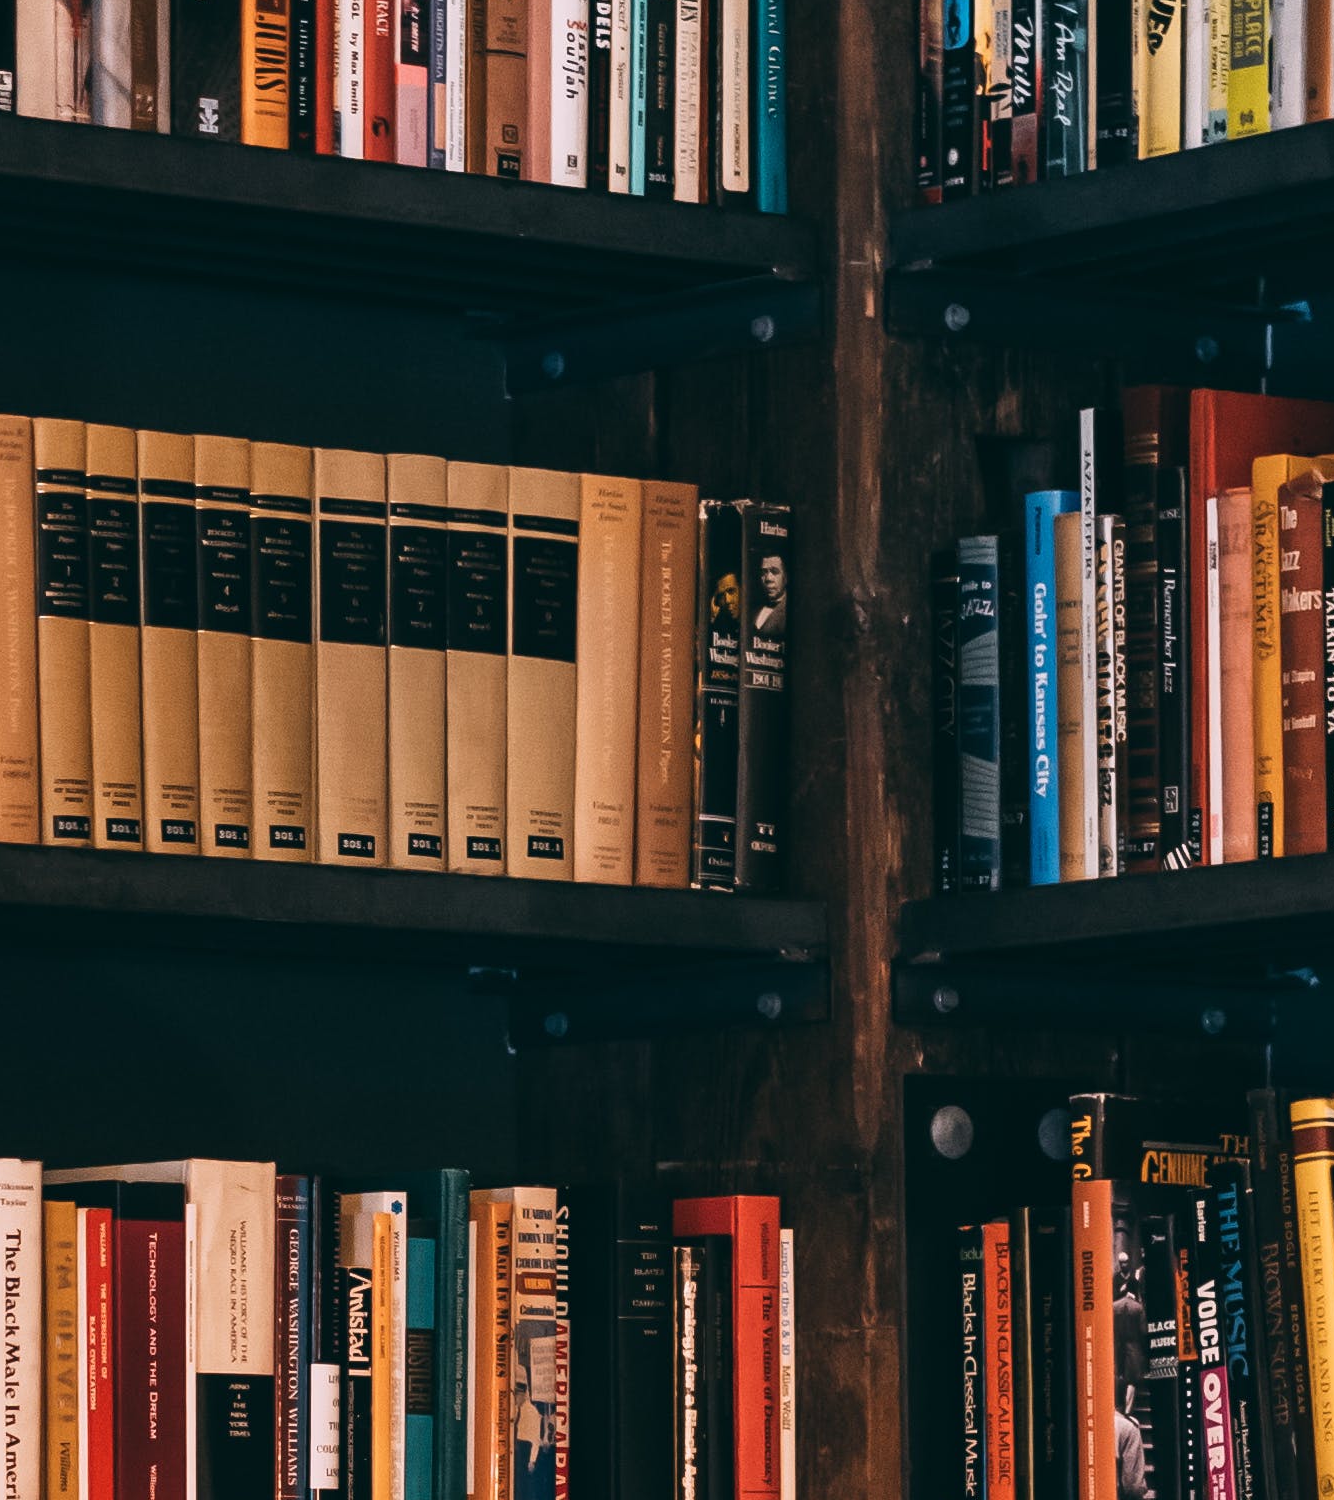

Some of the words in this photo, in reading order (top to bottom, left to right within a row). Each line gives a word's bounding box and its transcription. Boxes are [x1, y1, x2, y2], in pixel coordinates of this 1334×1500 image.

[253, 14, 289, 90] JUDAS
[2, 1229, 21, 1271] The
[286, 1228, 300, 1292] GEORGE
[2, 1275, 21, 1338] Black
[348, 1273, 371, 1364] Amistad
[1195, 1280, 1219, 1364] VOICE
[3, 1342, 21, 1401] Male
[286, 1298, 300, 1402] WASHINGTON
[3, 1406, 21, 1428] In
[286, 1408, 300, 1486] WILLIAMS
[1203, 1373, 1226, 1471] OVER
